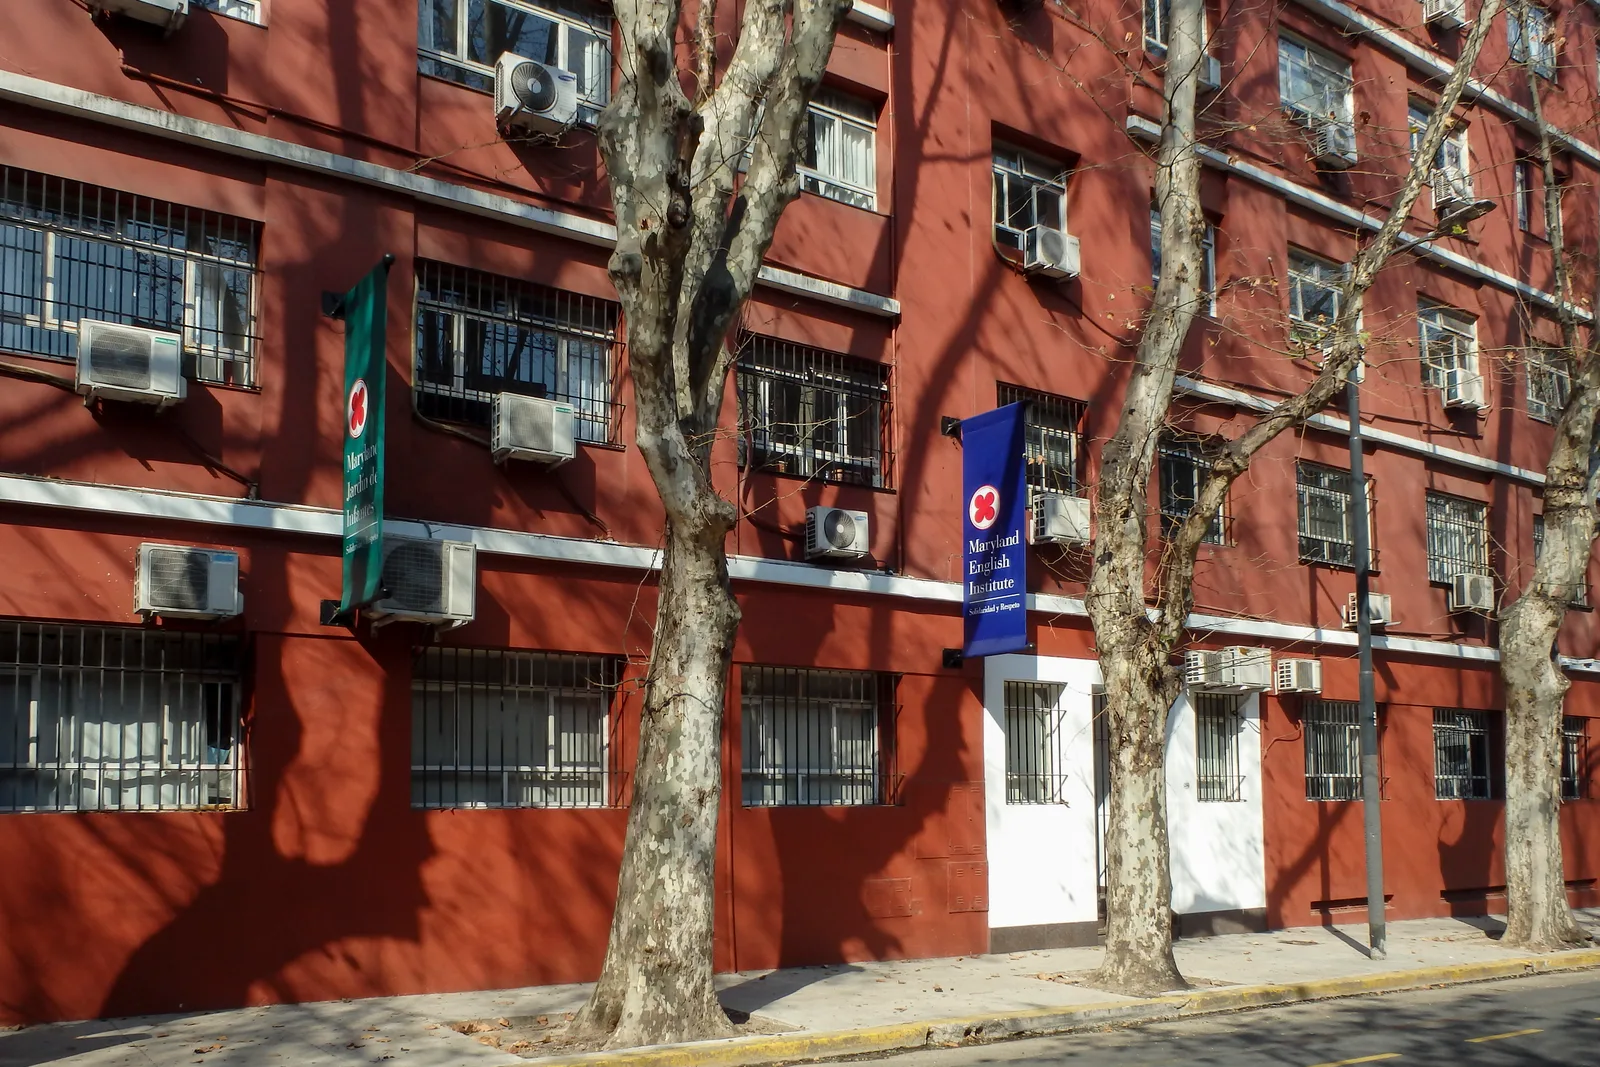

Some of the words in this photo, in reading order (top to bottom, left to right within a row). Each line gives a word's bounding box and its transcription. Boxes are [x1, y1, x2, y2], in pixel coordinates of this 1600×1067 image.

[968, 530, 1019, 555] Maryland
[968, 554, 1010, 576] English
[968, 578, 1015, 596] Institute
[968, 604, 996, 616] Solidaridad
[1000, 602, 1020, 611] Respeto
